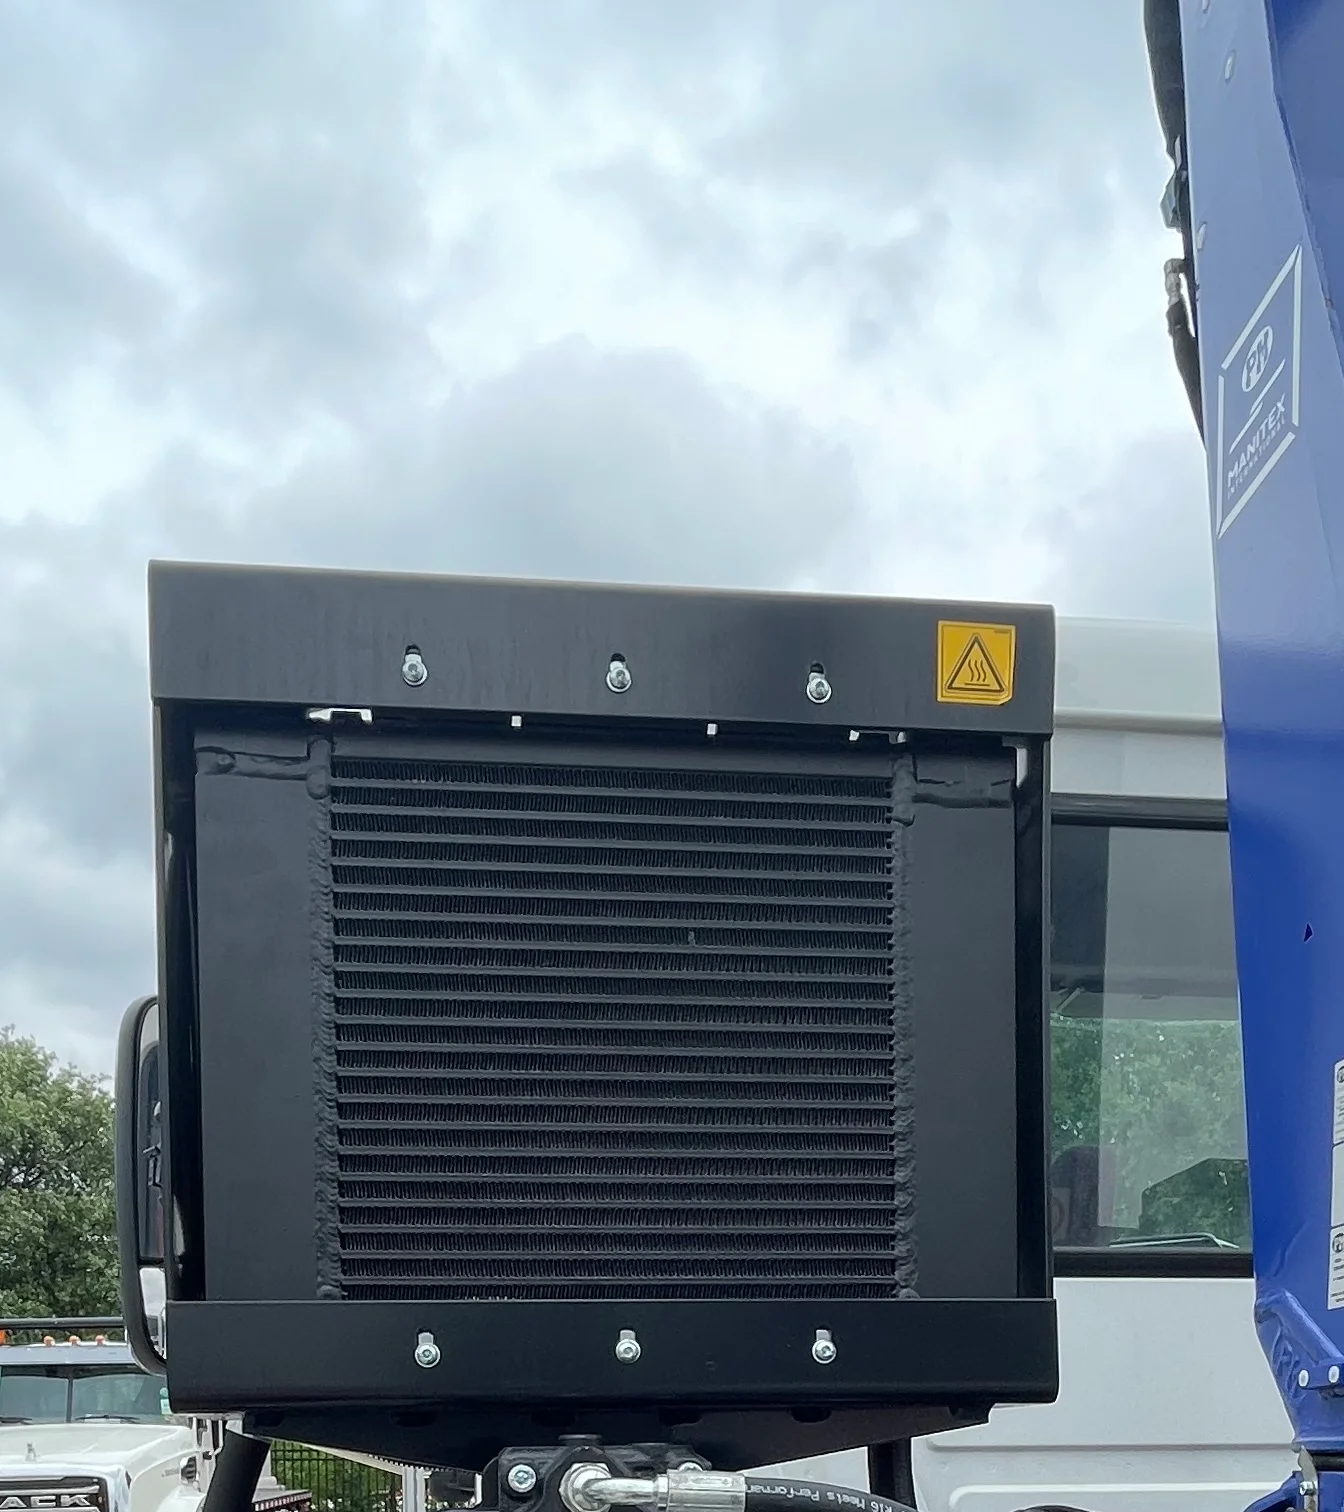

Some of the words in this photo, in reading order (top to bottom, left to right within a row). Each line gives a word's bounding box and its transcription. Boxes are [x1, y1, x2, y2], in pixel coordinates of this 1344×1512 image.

[1244, 327, 1271, 391] PM
[1227, 393, 1286, 488] MANITEX
[1227, 415, 1286, 500] INTERNATIONAL
[745, 1483, 820, 1501] Performan
[827, 1491, 866, 1510] Meets
